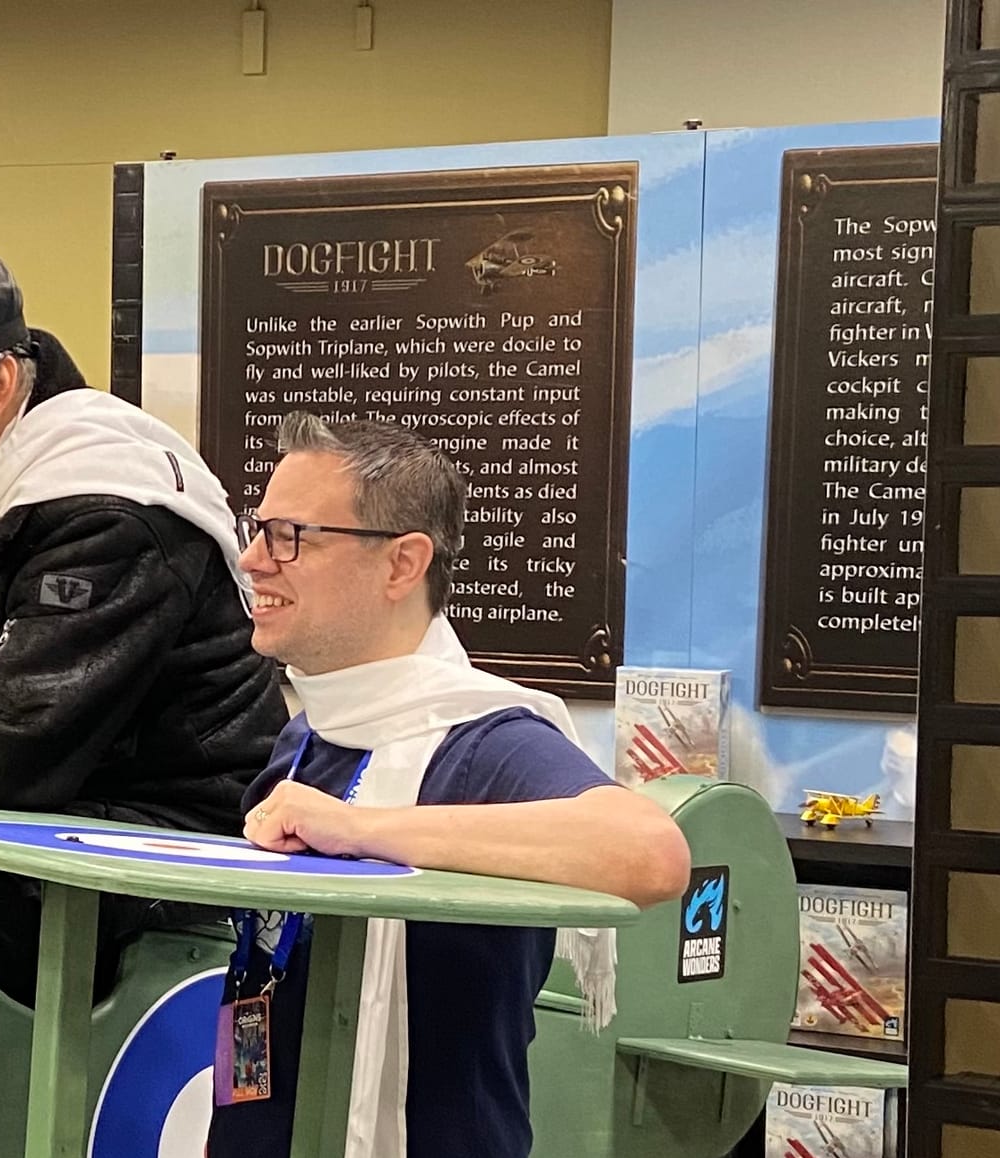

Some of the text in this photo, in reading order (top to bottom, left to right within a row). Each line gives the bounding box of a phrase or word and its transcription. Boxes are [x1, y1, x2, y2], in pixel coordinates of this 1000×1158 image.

[834, 216, 936, 237] The Sopw
[264, 238, 441, 277] DOGFIGHT
[834, 243, 933, 264] most sign
[333, 279, 368, 294] 1917
[832, 269, 908, 288] aircraft.
[831, 296, 906, 315] aircraft,
[247, 310, 581, 332] Unlike the earlier Sopwith Pup and
[830, 324, 896, 344] fighter
[902, 324, 919, 339] in
[247, 336, 581, 359] Sopwith Triplane, which were docile to
[829, 350, 898, 367] Vickers
[247, 360, 580, 382] fly and well-liked by pilots, the Camel
[246, 386, 580, 405] was unstable, requiring constant input
[827, 377, 900, 397] cockpit
[246, 411, 284, 429] from
[365, 410, 396, 424] The
[401, 410, 493, 430] gyroscopic
[499, 410, 555, 425] effects
[562, 409, 580, 425] of
[827, 403, 900, 424] making
[245, 435, 263, 449] its
[430, 435, 487, 454] engine
[503, 434, 551, 449] made
[567, 435, 578, 450] it
[825, 430, 894, 448] choice,
[480, 459, 512, 474] and
[519, 459, 578, 474] almost
[825, 456, 900, 477] military
[244, 485, 260, 495] as
[515, 487, 532, 498] as
[538, 484, 576, 499] died
[823, 482, 925, 500] The Came
[463, 507, 576, 527] tability also
[823, 509, 922, 529] in July 19
[483, 532, 524, 550] agile
[543, 533, 575, 548] and
[822, 534, 887, 554] fighter
[489, 556, 507, 571] its
[527, 557, 575, 576] tricky
[820, 562, 923, 581] approxima
[546, 581, 574, 597] the
[820, 587, 833, 602] is
[842, 586, 887, 604] built
[488, 605, 562, 623] airplane.
[818, 615, 918, 634] completel
[626, 680, 709, 699] DOGFIGHT
[801, 896, 894, 919] DOGFIGHT
[683, 937, 721, 958] ARCANE
[683, 955, 720, 976] WONDERS
[777, 1091, 872, 1117] DOGFIGHT
